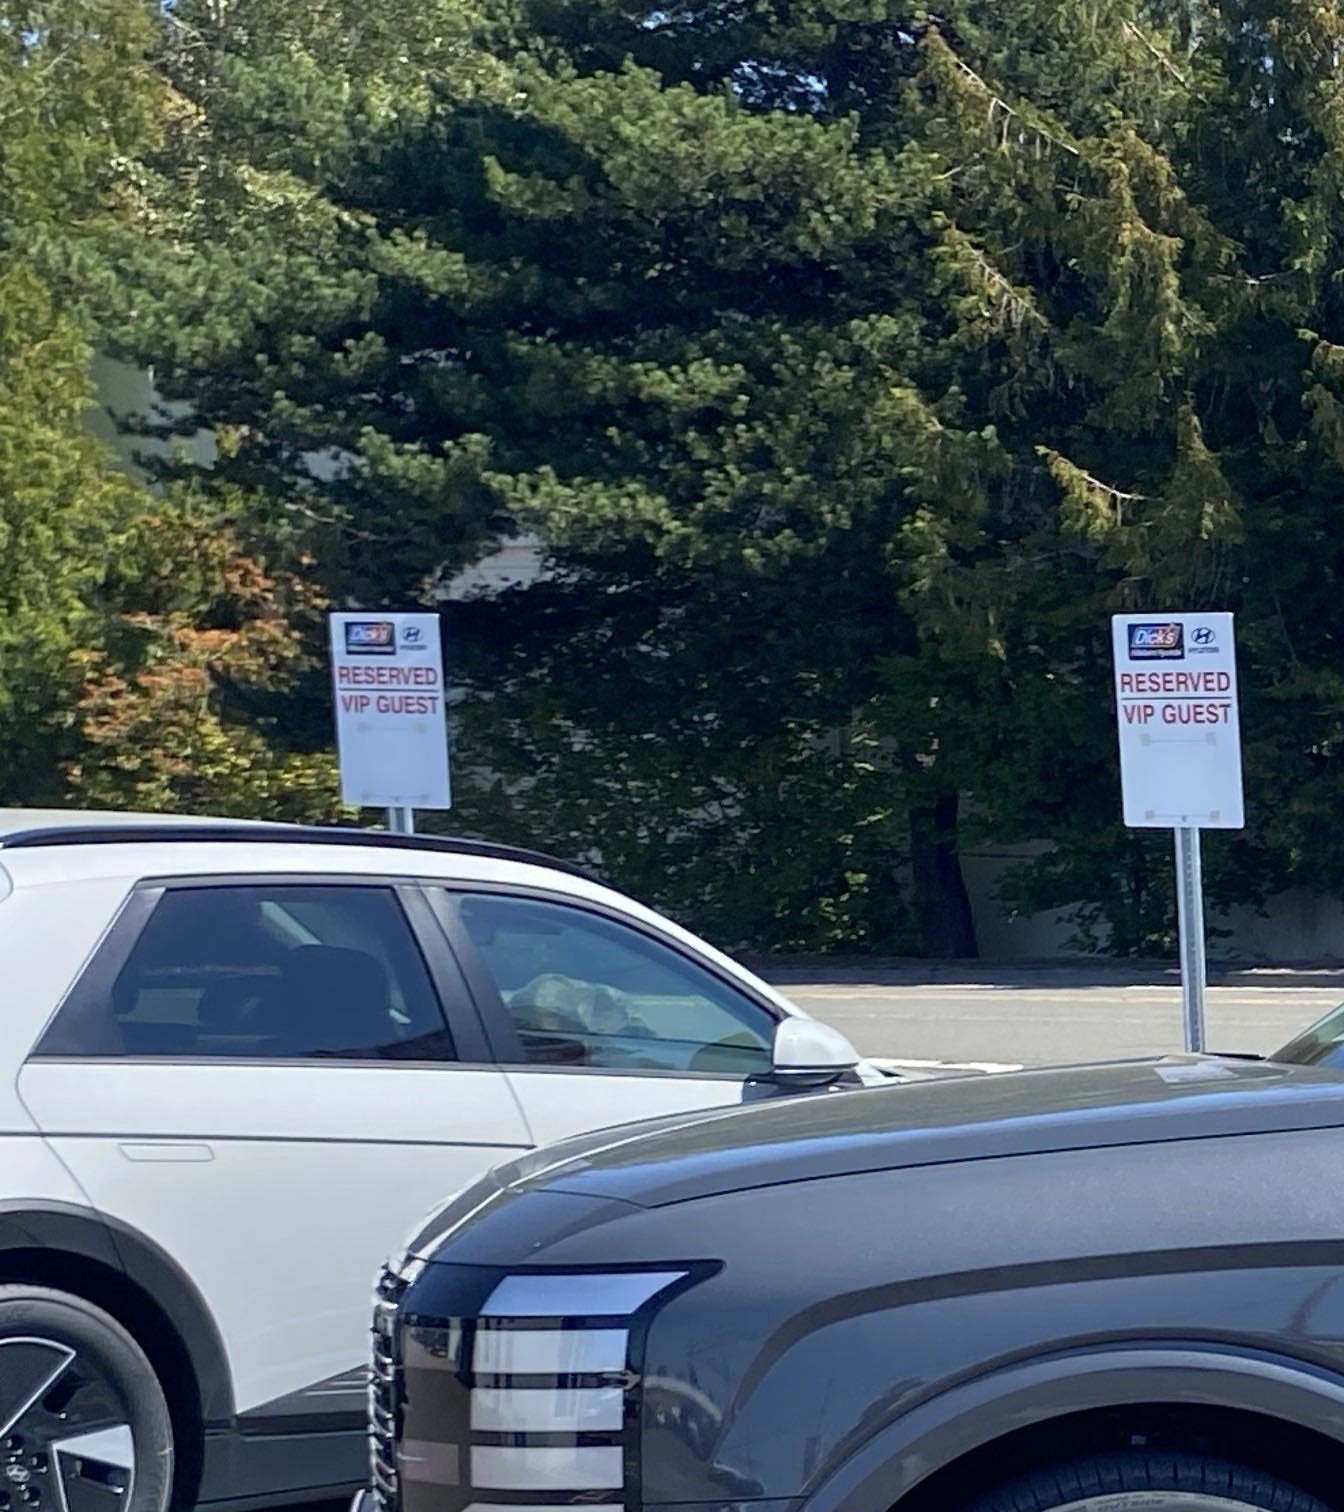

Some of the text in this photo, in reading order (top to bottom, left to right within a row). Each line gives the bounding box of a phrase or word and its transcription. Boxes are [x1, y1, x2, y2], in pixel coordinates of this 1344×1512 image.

[338, 666, 437, 685] RESERVED
[1120, 672, 1231, 692] RESERVED
[342, 695, 439, 714] VIP GUEST
[1123, 704, 1231, 724] VIP GUEST
